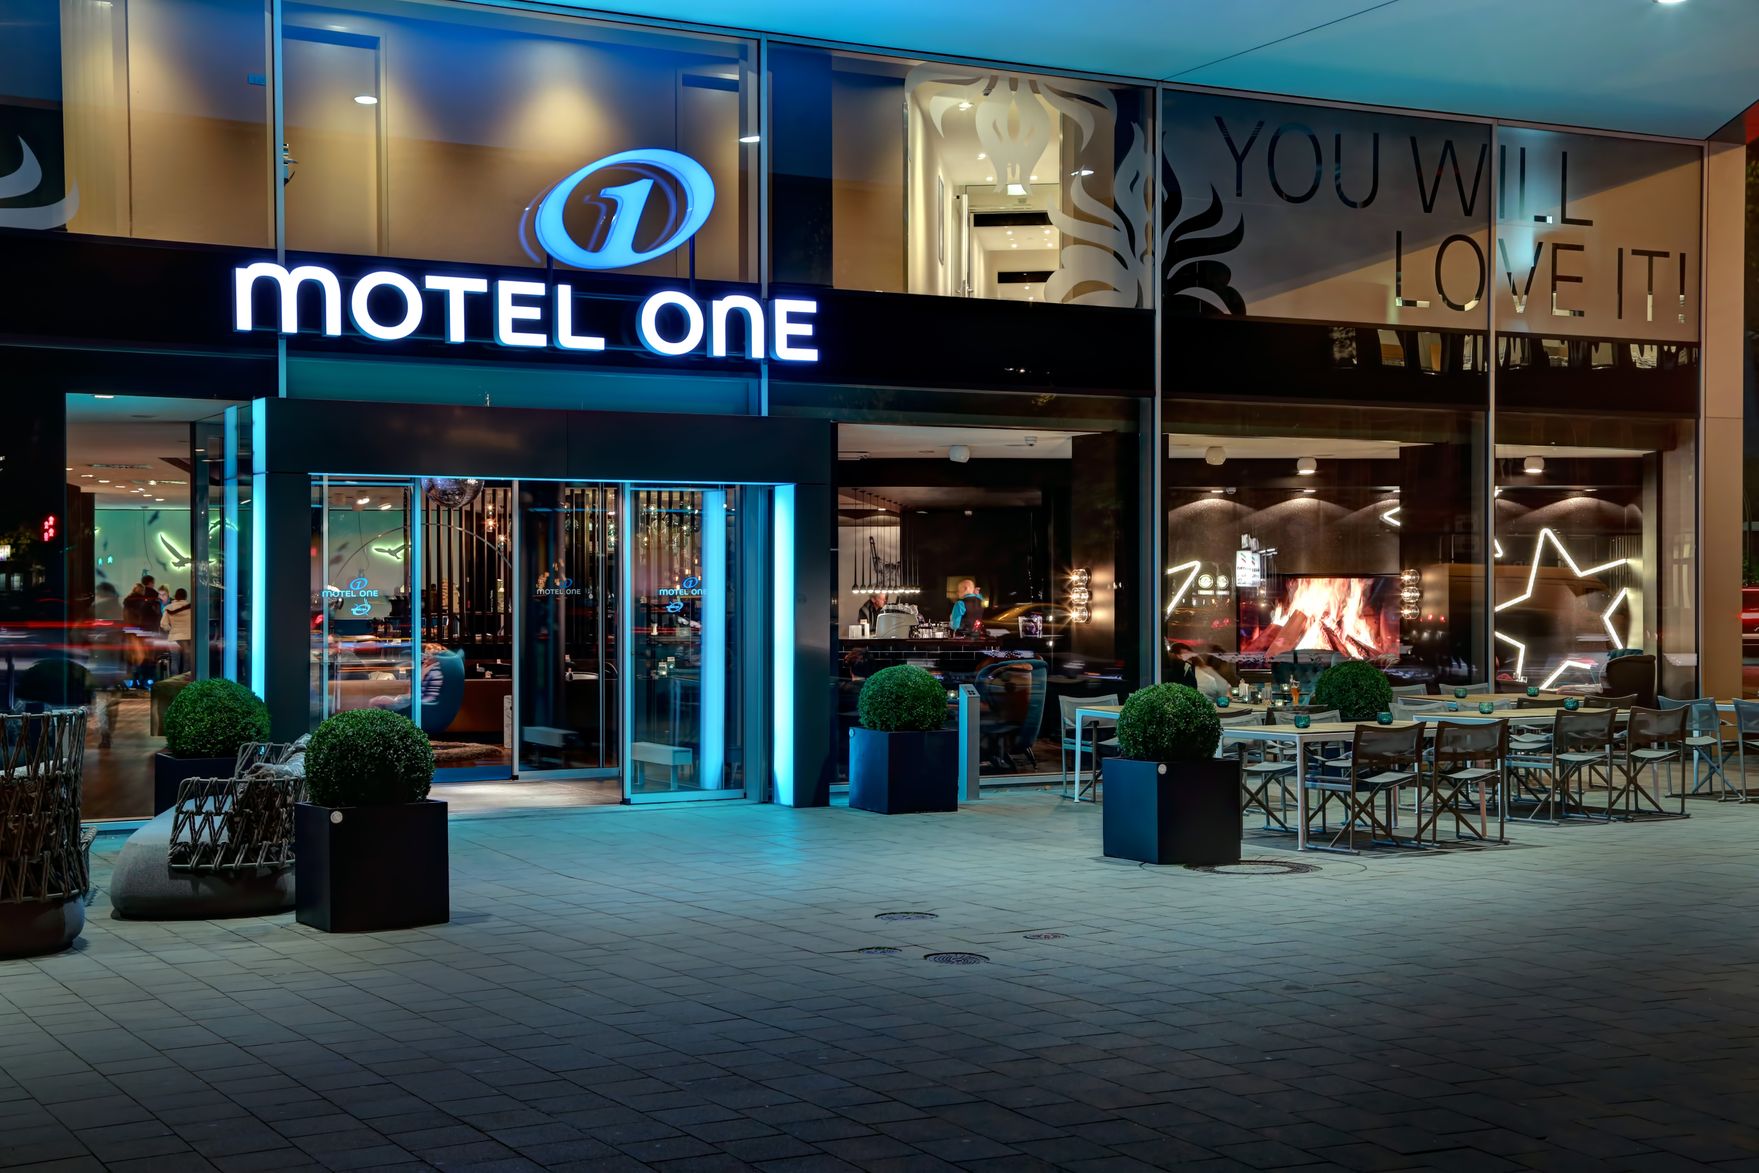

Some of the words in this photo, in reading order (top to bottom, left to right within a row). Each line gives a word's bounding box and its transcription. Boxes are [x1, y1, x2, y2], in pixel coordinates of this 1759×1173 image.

[1213, 115, 1380, 209] YOU
[1409, 134, 1594, 228] WILL
[232, 261, 605, 352] MOTEL
[636, 289, 819, 362] ONE
[1395, 230, 1585, 318] LOVE
[1616, 247, 1687, 325] IT!
